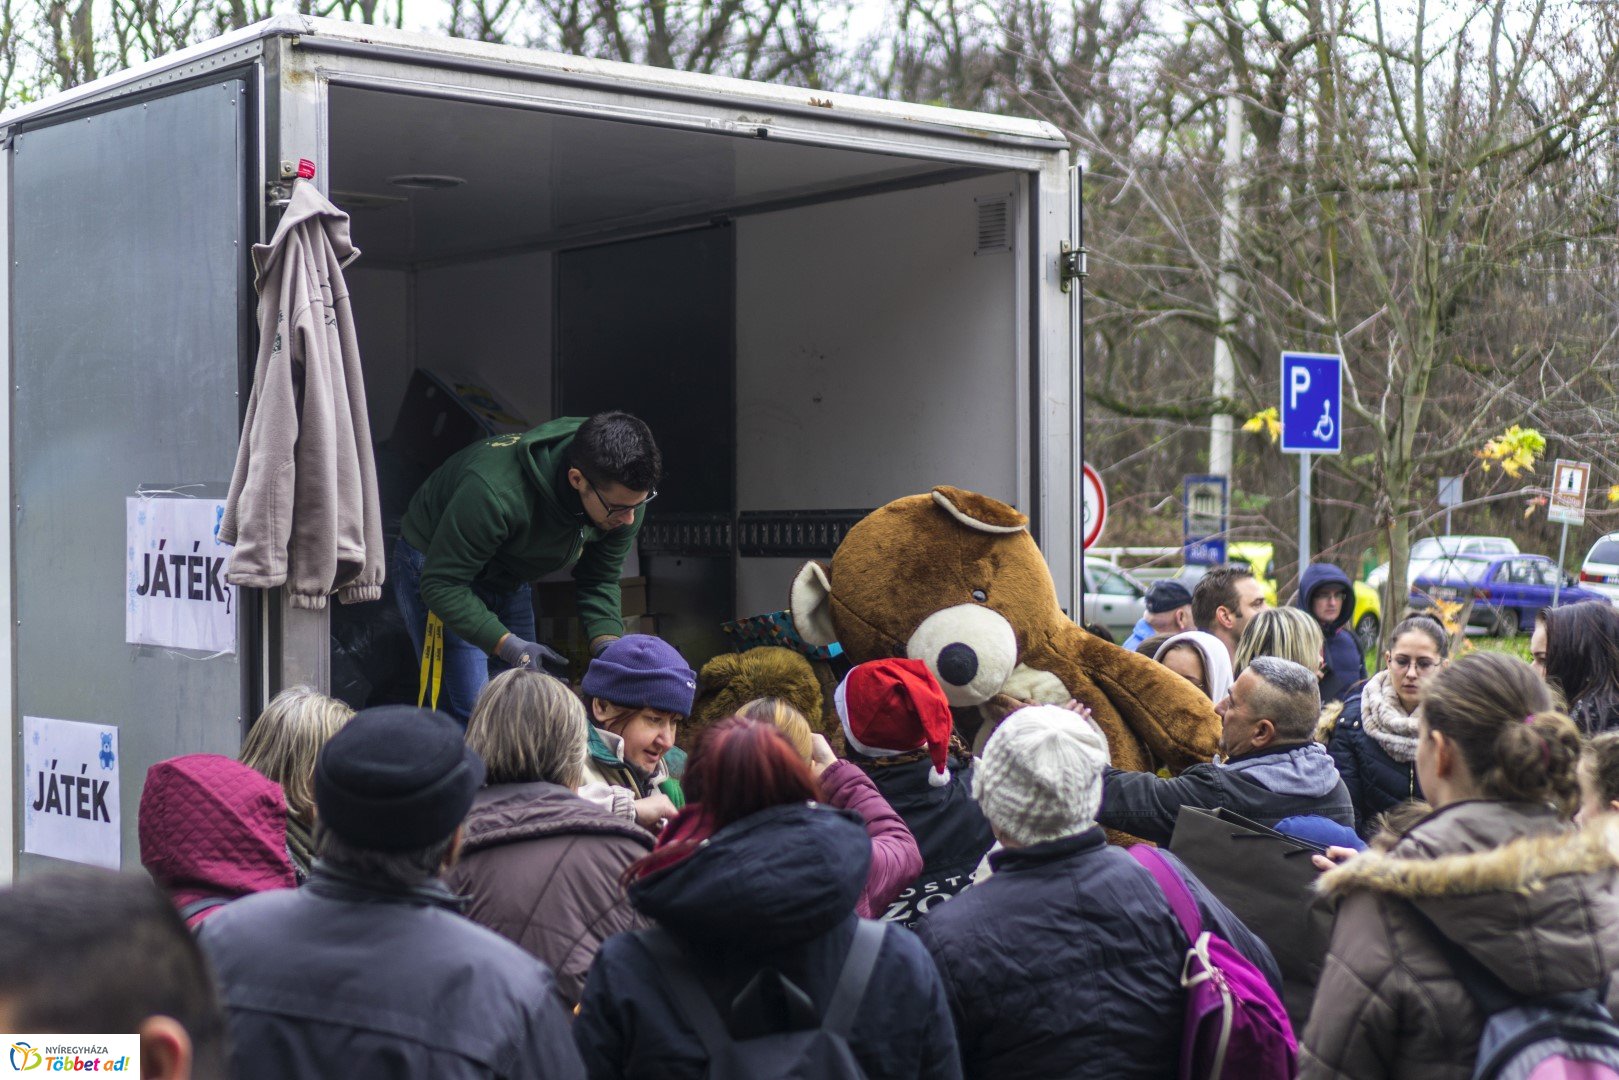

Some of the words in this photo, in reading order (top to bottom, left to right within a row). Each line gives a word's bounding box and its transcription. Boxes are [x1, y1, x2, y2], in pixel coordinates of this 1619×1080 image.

[1290, 366, 1311, 410] P
[136, 539, 226, 603] JÁTÉK
[32, 759, 111, 824] JÁTÉK
